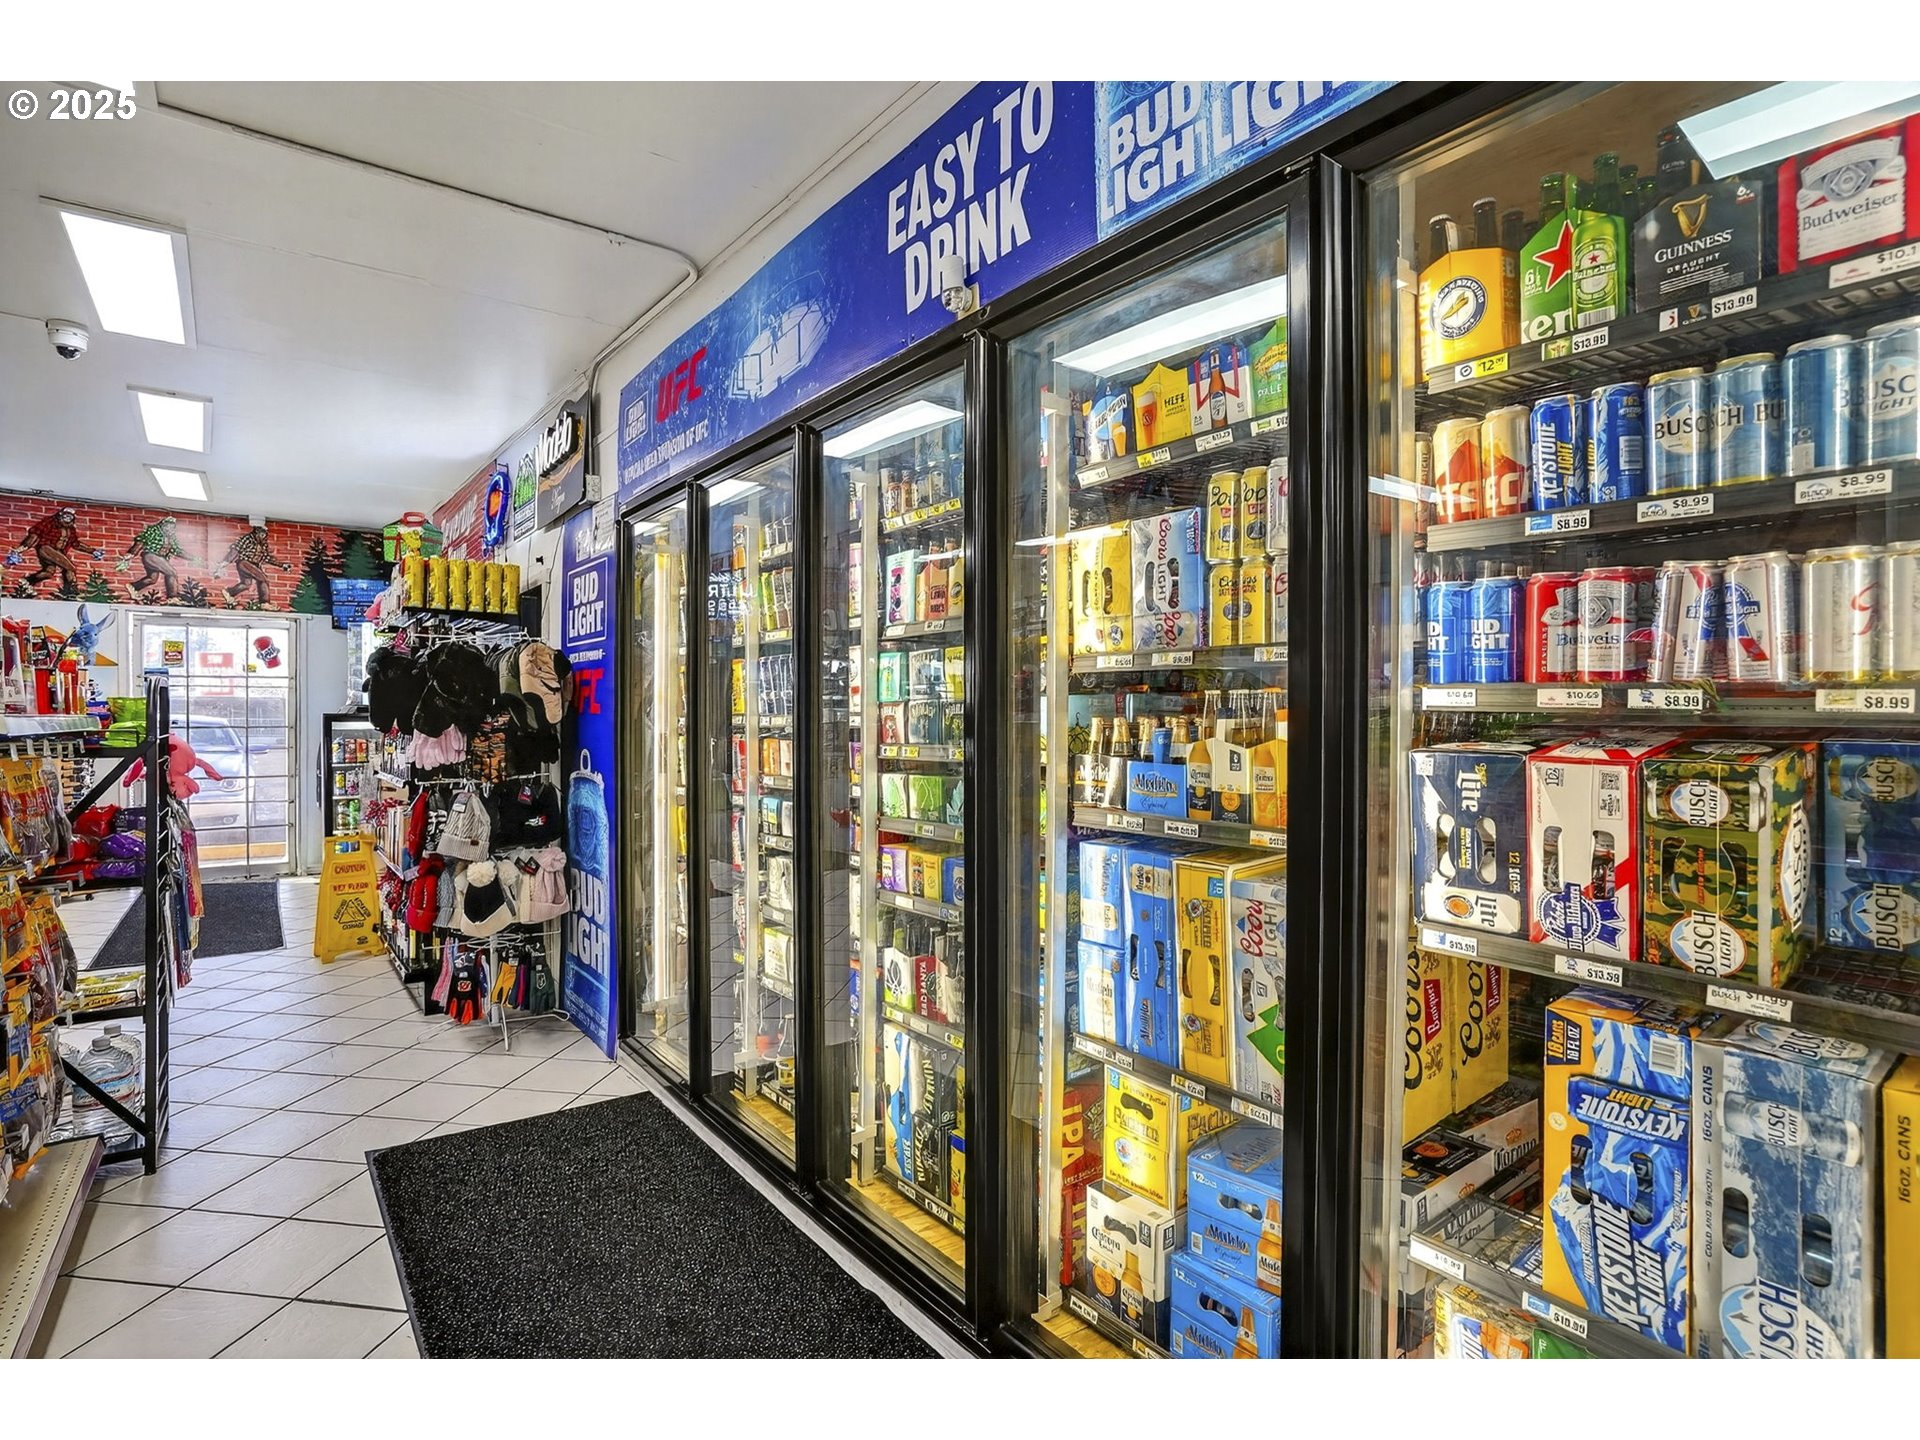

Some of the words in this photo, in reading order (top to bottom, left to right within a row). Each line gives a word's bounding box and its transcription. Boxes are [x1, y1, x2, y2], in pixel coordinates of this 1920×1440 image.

[1109, 81, 1200, 166] BUD
[887, 116, 983, 254] EASY
[993, 81, 1054, 175] TO
[1802, 192, 1898, 231] Budweiser
[905, 165, 1031, 315] DRINK
[1654, 228, 1734, 263] GUINNESS
[1714, 294, 1754, 314] $13.99
[1574, 334, 1606, 351] $13.99
[656, 346, 707, 424] UFC
[1558, 441, 1574, 475] LIGHT
[1839, 472, 1886, 488] $8.99
[1157, 518, 1172, 560] Coors
[1557, 517, 1587, 530] $8.99
[573, 570, 598, 606] BUD
[1157, 562, 1167, 602] LIGHT
[569, 600, 604, 638] LIGHT
[1664, 695, 1699, 707] $8.99
[1864, 696, 1910, 709] $8.99
[1457, 769, 1482, 813] Lite
[1876, 755, 1897, 804] BUSCH
[1690, 779, 1709, 827] BUSCH
[1708, 789, 1718, 820] LIGHT
[1508, 851, 1520, 864] 12
[1239, 899, 1264, 958] Coors
[1264, 903, 1278, 957] LIGHT
[1476, 894, 1497, 928] Lite
[1876, 884, 1901, 950] BUSCH
[1694, 911, 1718, 977] BUSCH
[1720, 927, 1732, 970] LIGHT
[1606, 1088, 1655, 1109] LIGHT
[1702, 1065, 1713, 1106] CANS
[1576, 1094, 1686, 1142] KEYSTONE
[1768, 1103, 1787, 1147] BUSCH
[1788, 1113, 1798, 1143] LIGHT
[1898, 1115, 1912, 1162] CANS
[1592, 1191, 1652, 1331] KEYSTONE
[1634, 1240, 1667, 1307] LIGHT
